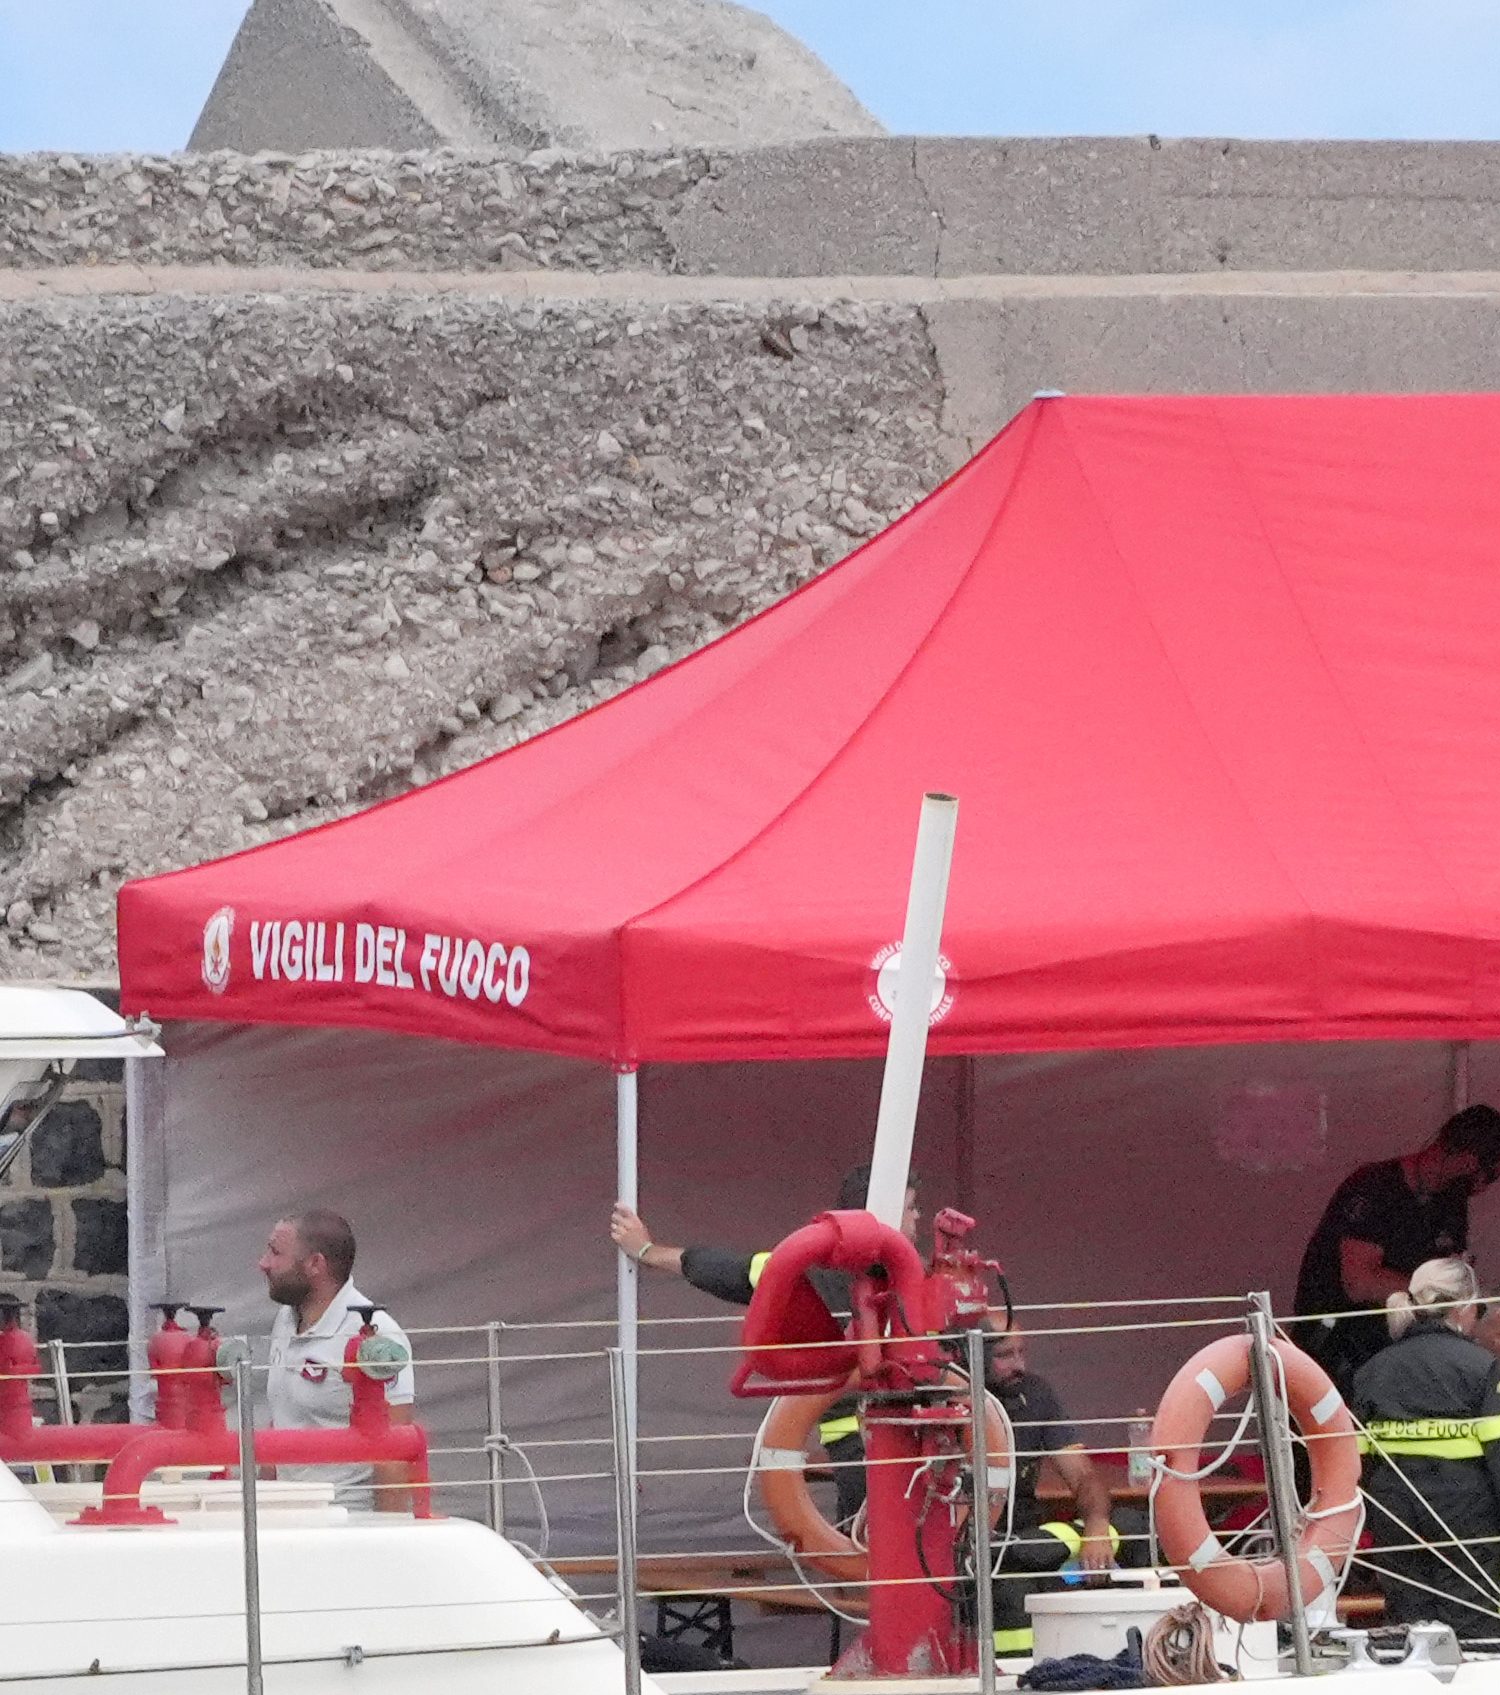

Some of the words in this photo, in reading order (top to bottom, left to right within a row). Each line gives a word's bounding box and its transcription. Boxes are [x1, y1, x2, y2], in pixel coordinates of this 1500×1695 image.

[250, 921, 345, 982] VIGILI
[355, 923, 414, 988] DEL
[420, 934, 531, 1007] FUOCO
[1396, 1420, 1424, 1437] DEL
